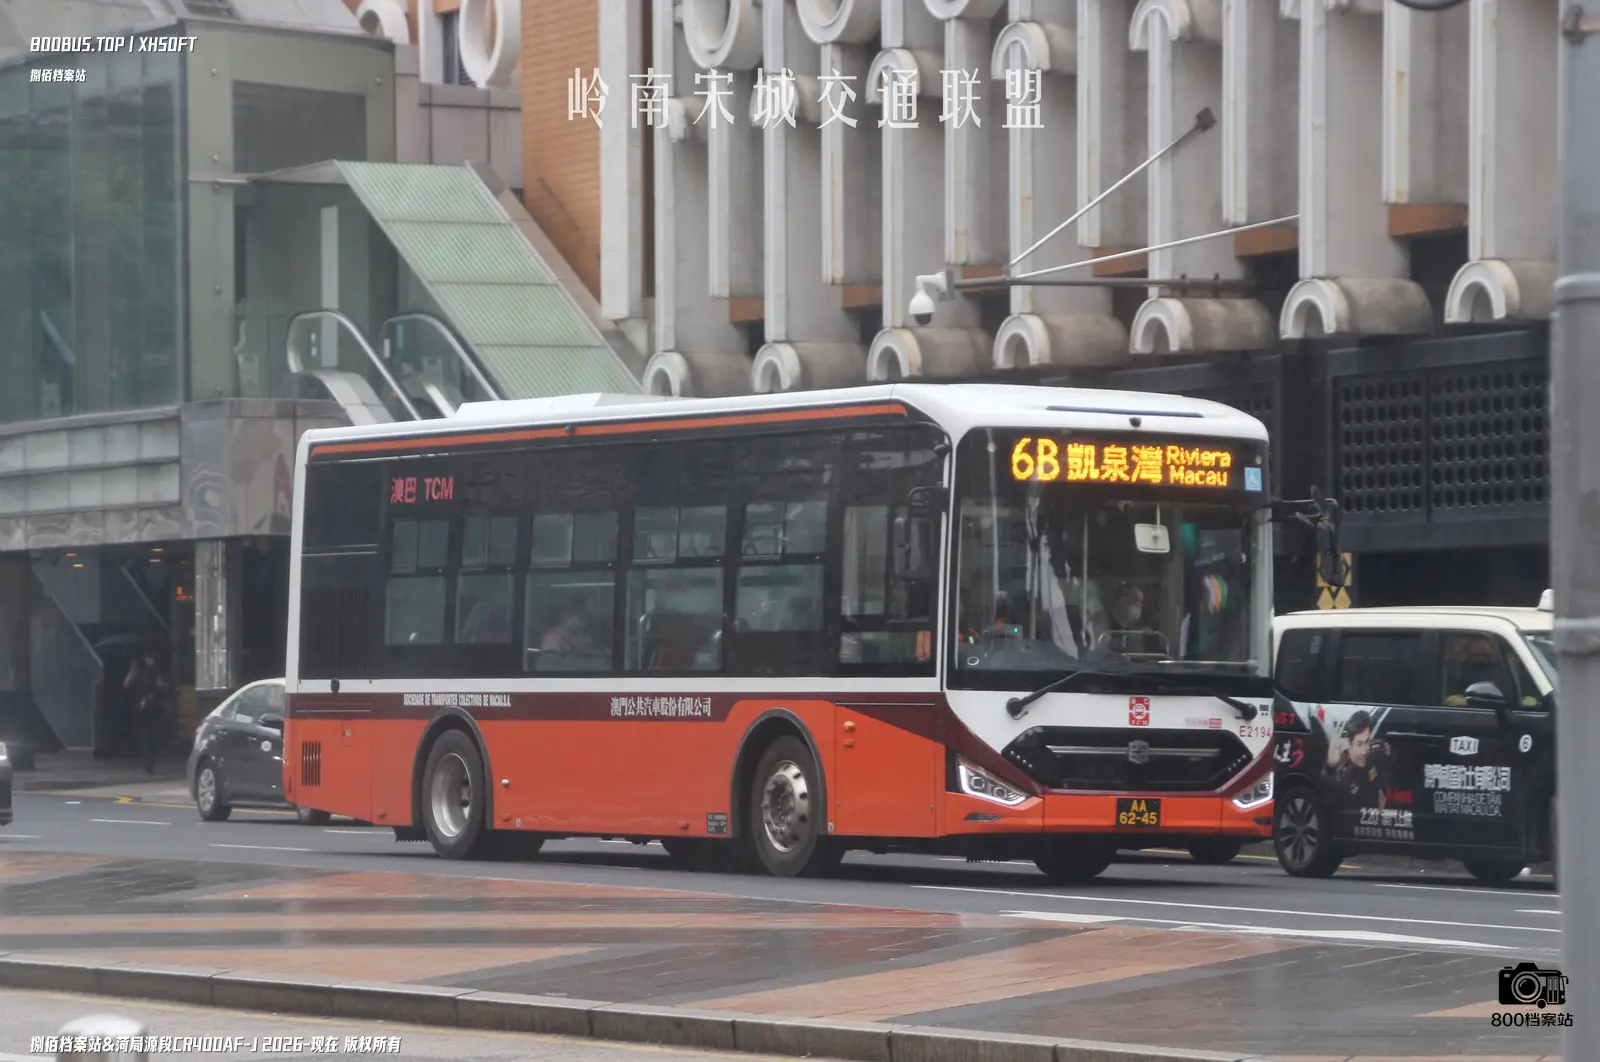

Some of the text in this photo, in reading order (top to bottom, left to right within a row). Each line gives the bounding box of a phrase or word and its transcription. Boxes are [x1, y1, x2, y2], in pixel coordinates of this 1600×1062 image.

[1011, 437, 1164, 483] 6B 凱泉灣
[1166, 445, 1233, 468] Riviera
[1168, 465, 1229, 487] Macau
[390, 476, 455, 504] 澳巴 TCM
[610, 696, 713, 717] 澳門公共汽車股份有限公司
[1239, 726, 1272, 738] E2194
[1453, 738, 1478, 752] TAXI
[1522, 736, 1531, 750] 6
[1131, 800, 1147, 812] AA
[1119, 812, 1158, 825] 62-45
